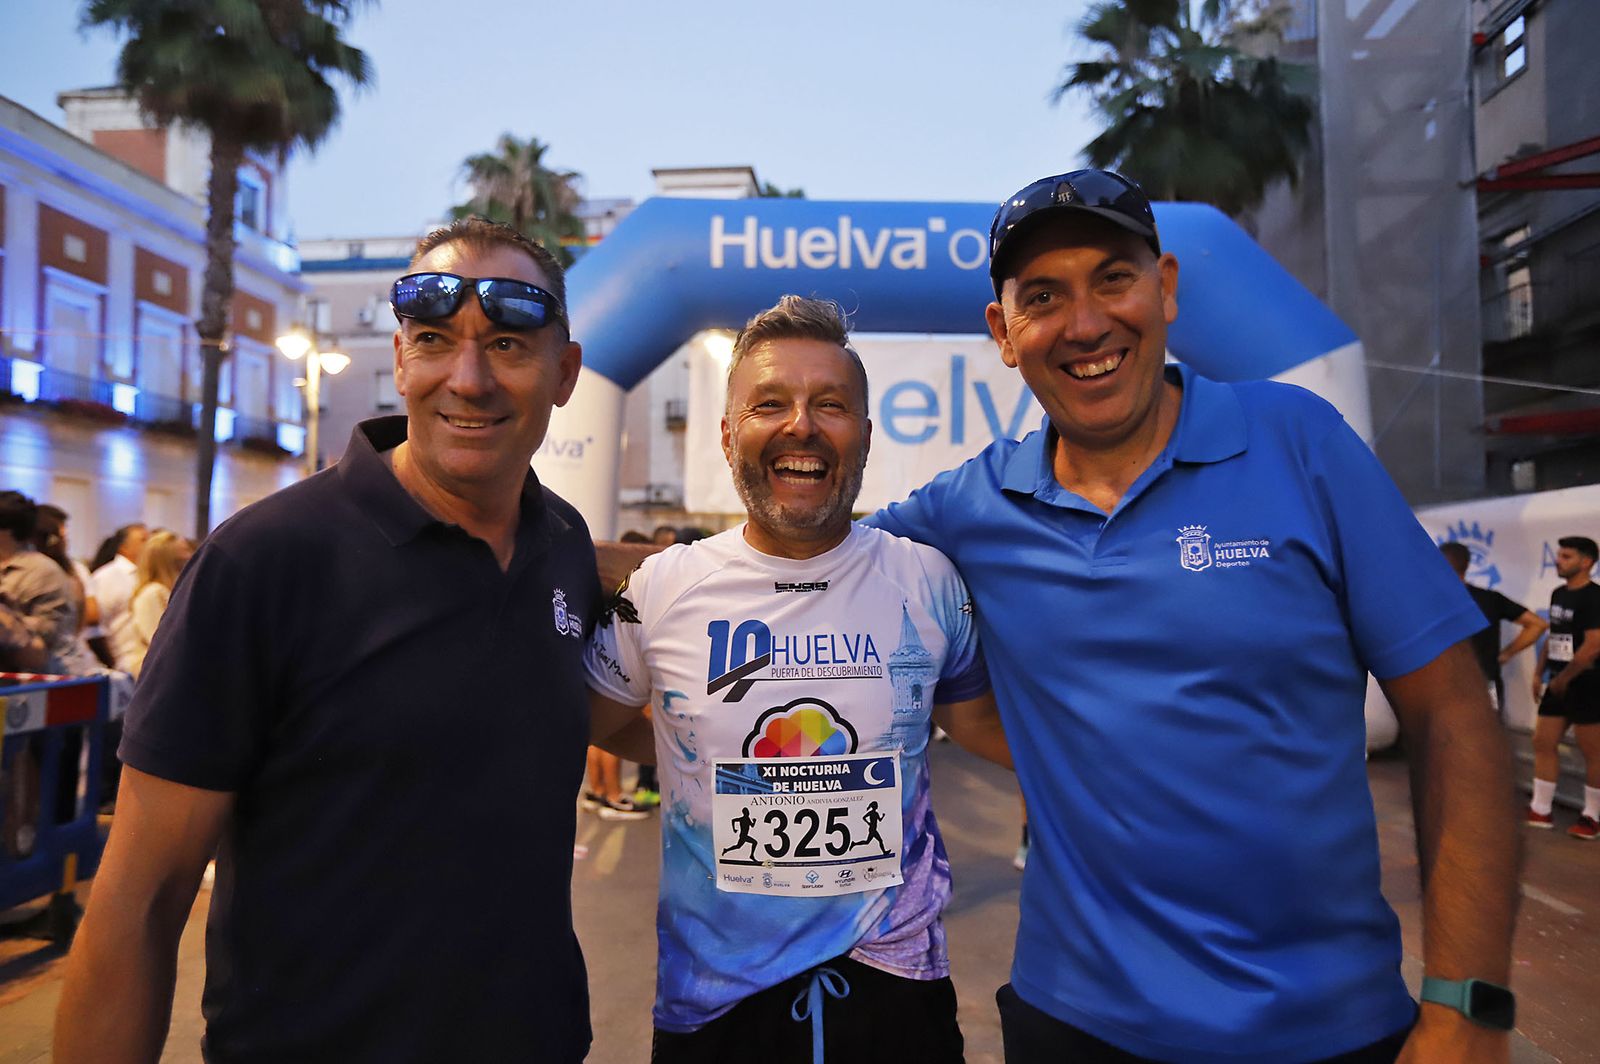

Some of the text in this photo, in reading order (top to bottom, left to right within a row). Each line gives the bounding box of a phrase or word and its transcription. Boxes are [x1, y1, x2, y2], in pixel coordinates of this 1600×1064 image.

[710, 215, 927, 270] Huelva
[1215, 547, 1270, 560] HUELVA
[1216, 560, 1250, 568] Deportes
[772, 633, 881, 665] HUELVA
[771, 665, 883, 678] PUERTA DEL DESCUBRIMIENTO
[762, 763, 850, 778] XI NOCTURNA
[773, 780, 843, 793] DE HUELVA
[750, 795, 806, 806] ANTONIO
[764, 807, 850, 858] 325
[723, 874, 752, 884] Huelva
